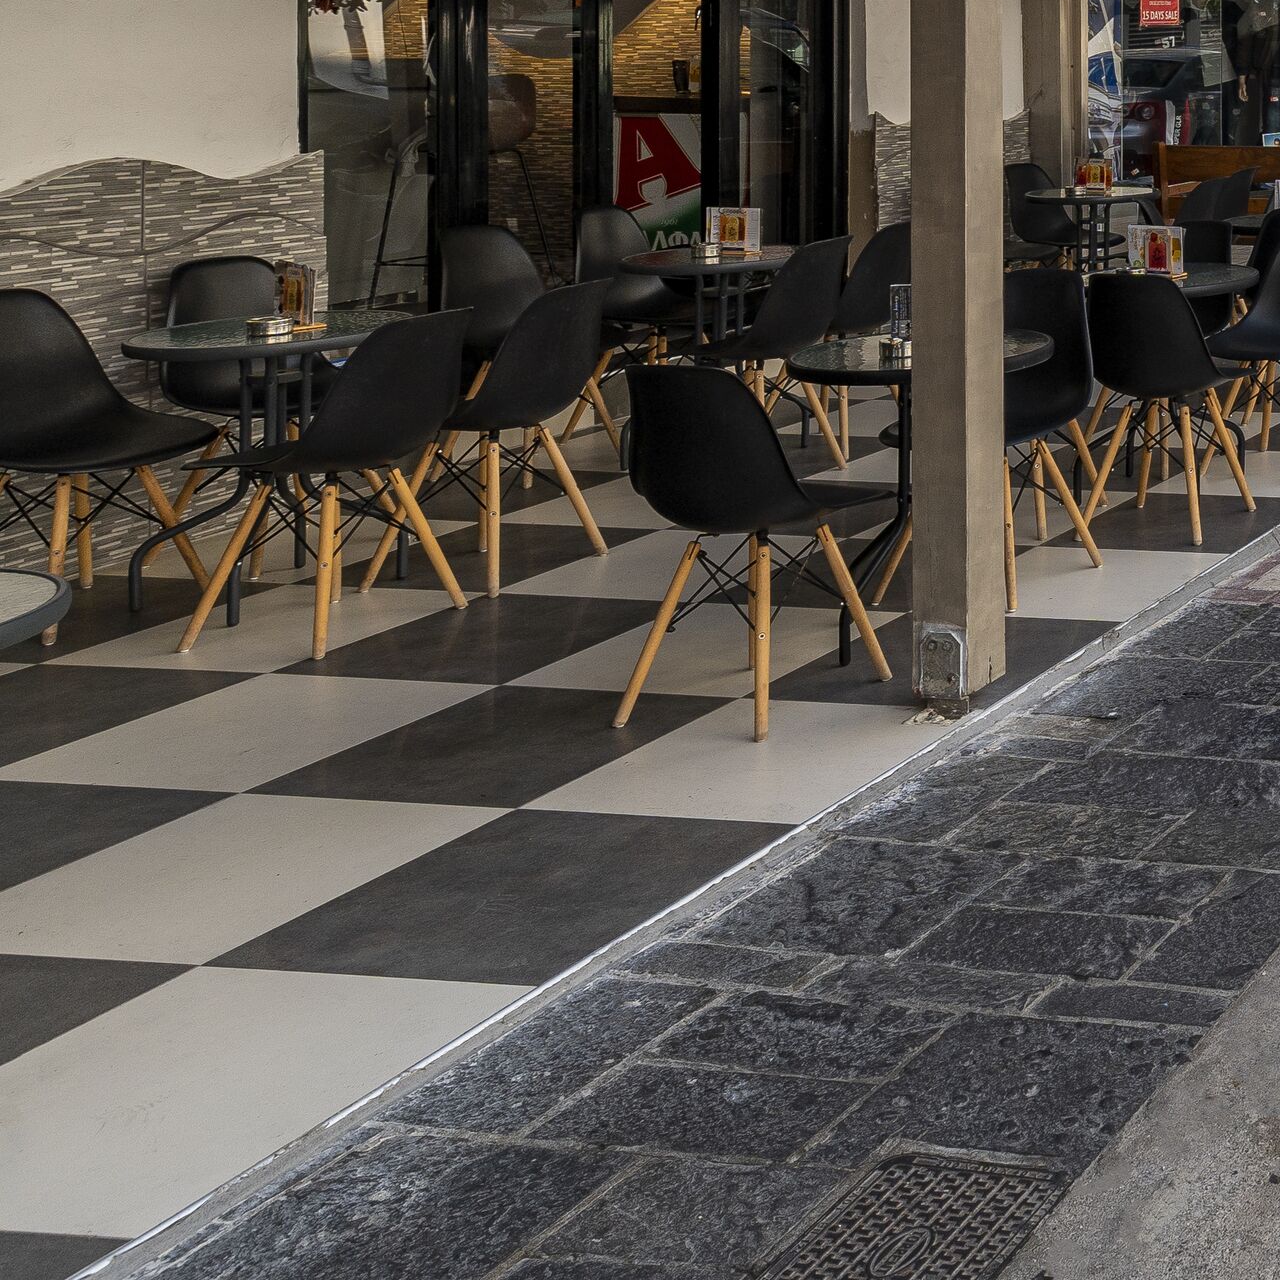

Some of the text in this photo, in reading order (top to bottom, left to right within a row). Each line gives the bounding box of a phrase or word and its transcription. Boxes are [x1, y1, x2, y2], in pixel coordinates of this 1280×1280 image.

[1142, 11, 1178, 20] 15 DAYS SALE
